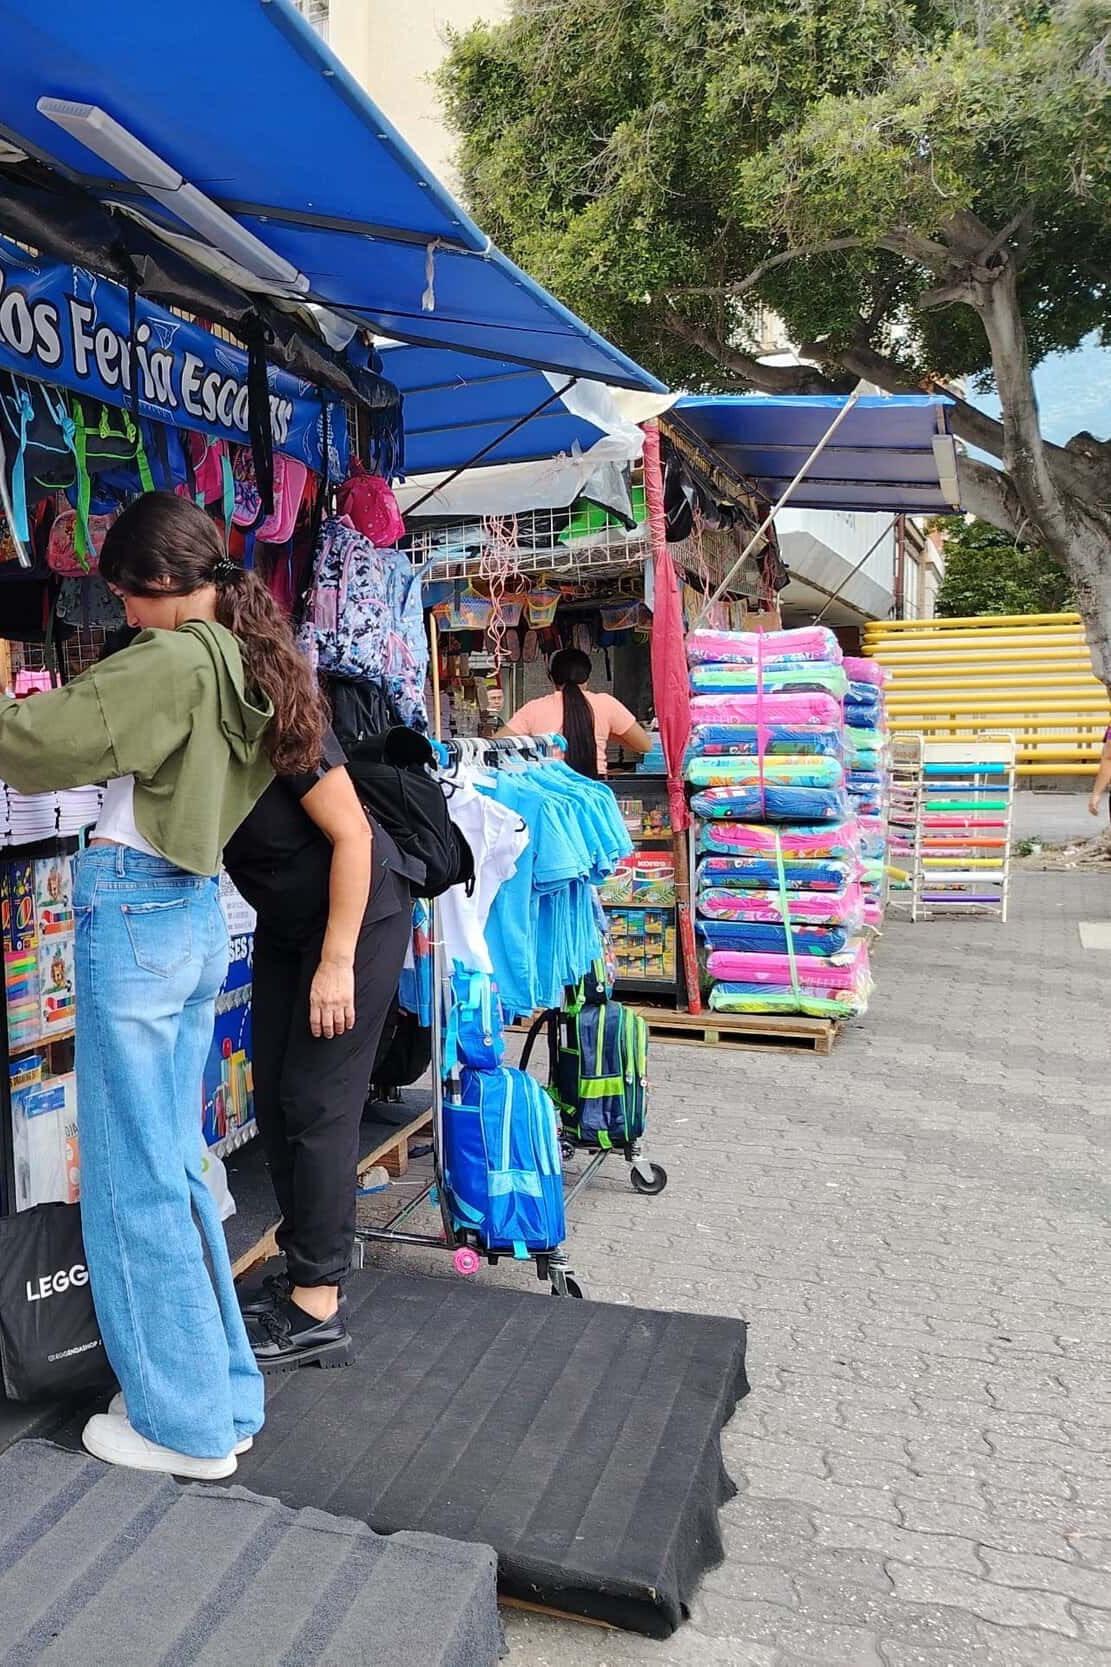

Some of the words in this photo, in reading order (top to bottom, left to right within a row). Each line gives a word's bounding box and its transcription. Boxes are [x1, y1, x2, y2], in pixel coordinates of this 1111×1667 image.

[70, 299, 178, 408] Feria
[182, 352, 293, 445] Escoar
[26, 1264, 89, 1302] LEGG
